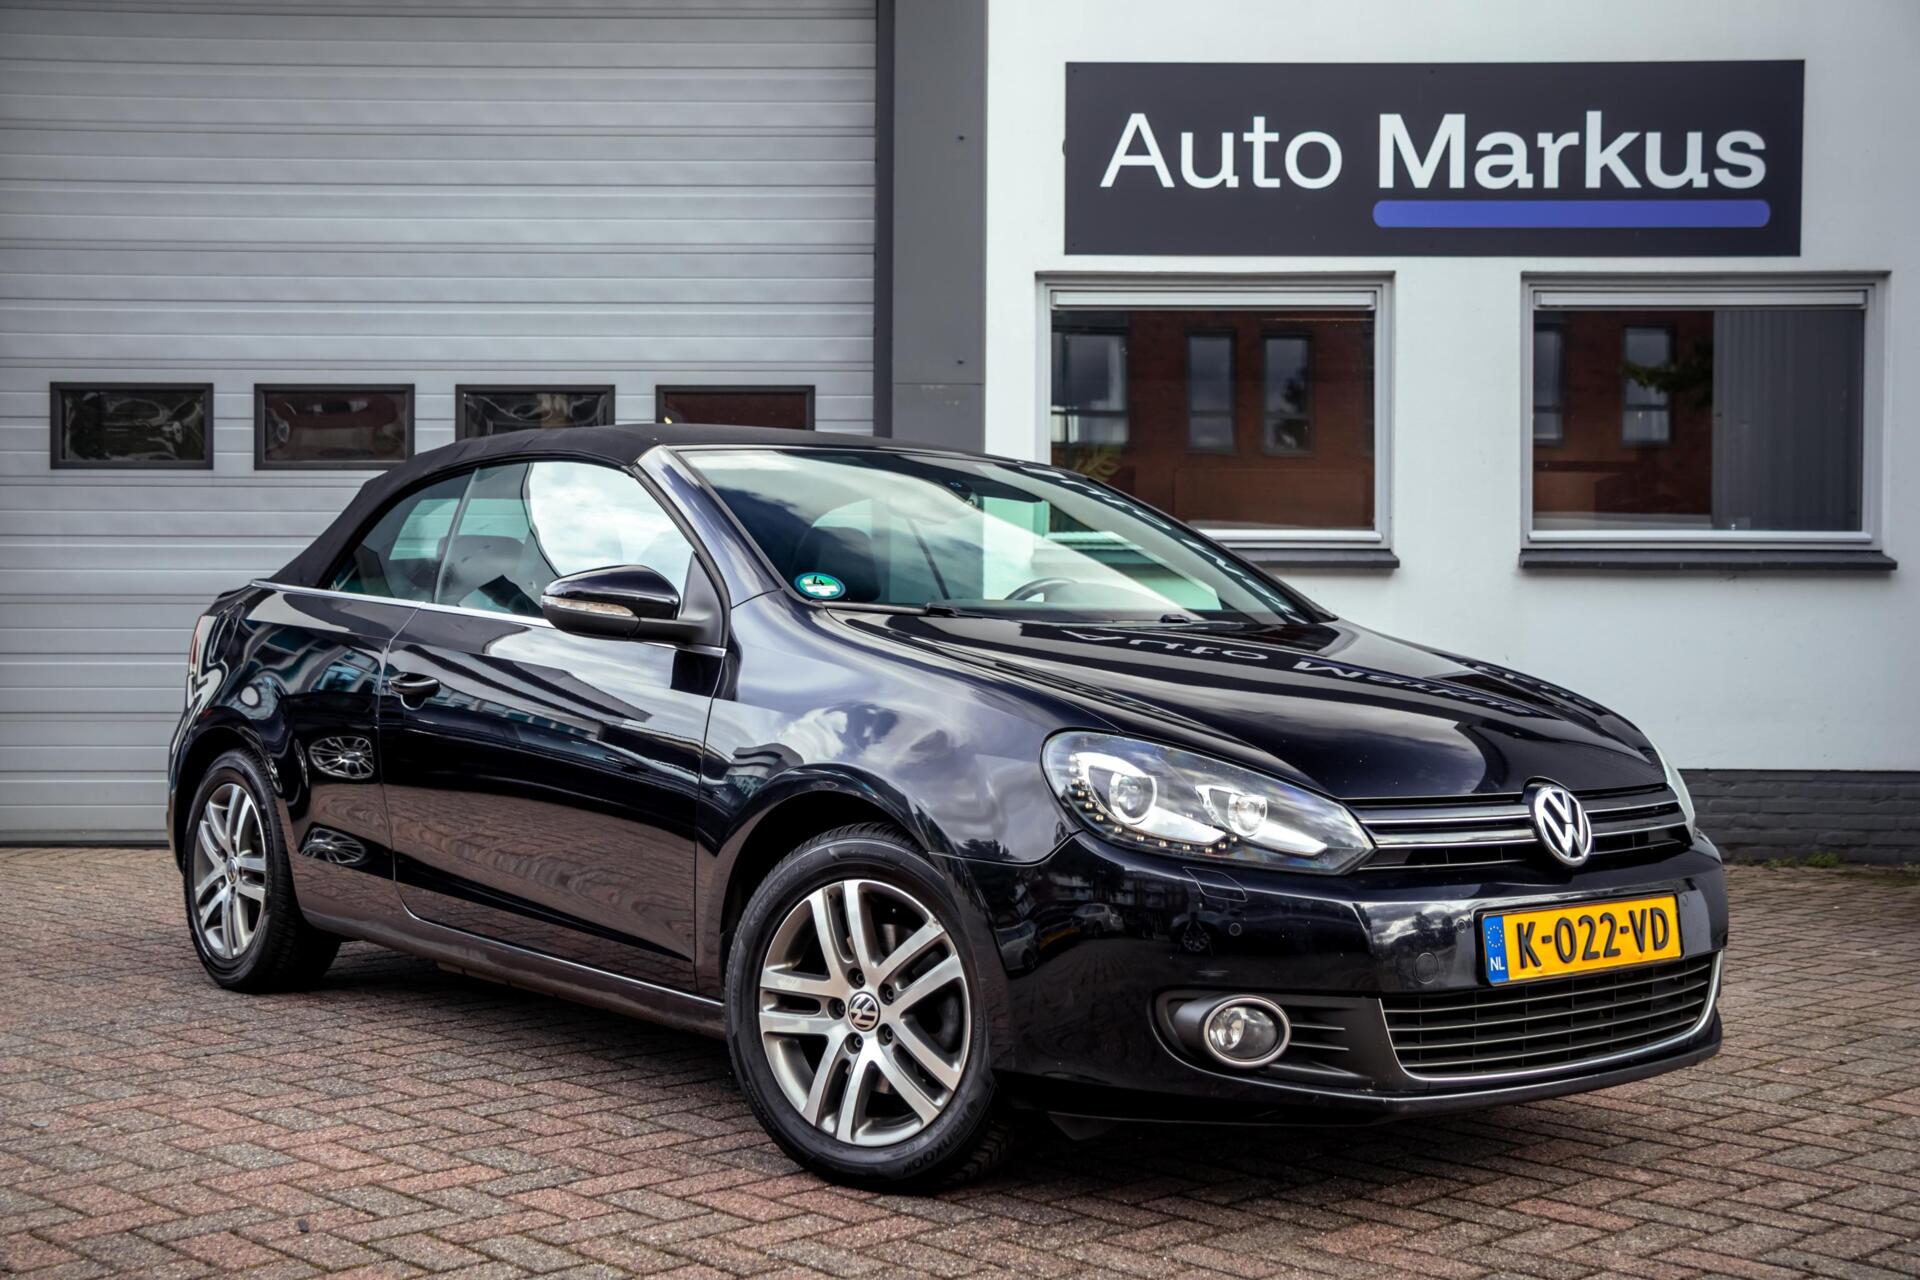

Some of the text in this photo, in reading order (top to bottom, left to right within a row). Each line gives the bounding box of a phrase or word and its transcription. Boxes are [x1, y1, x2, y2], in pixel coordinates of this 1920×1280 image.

[1101, 111, 1764, 189] Auto Markus
[1490, 956, 1505, 971] NL
[1516, 907, 1670, 969] K-022-VD
